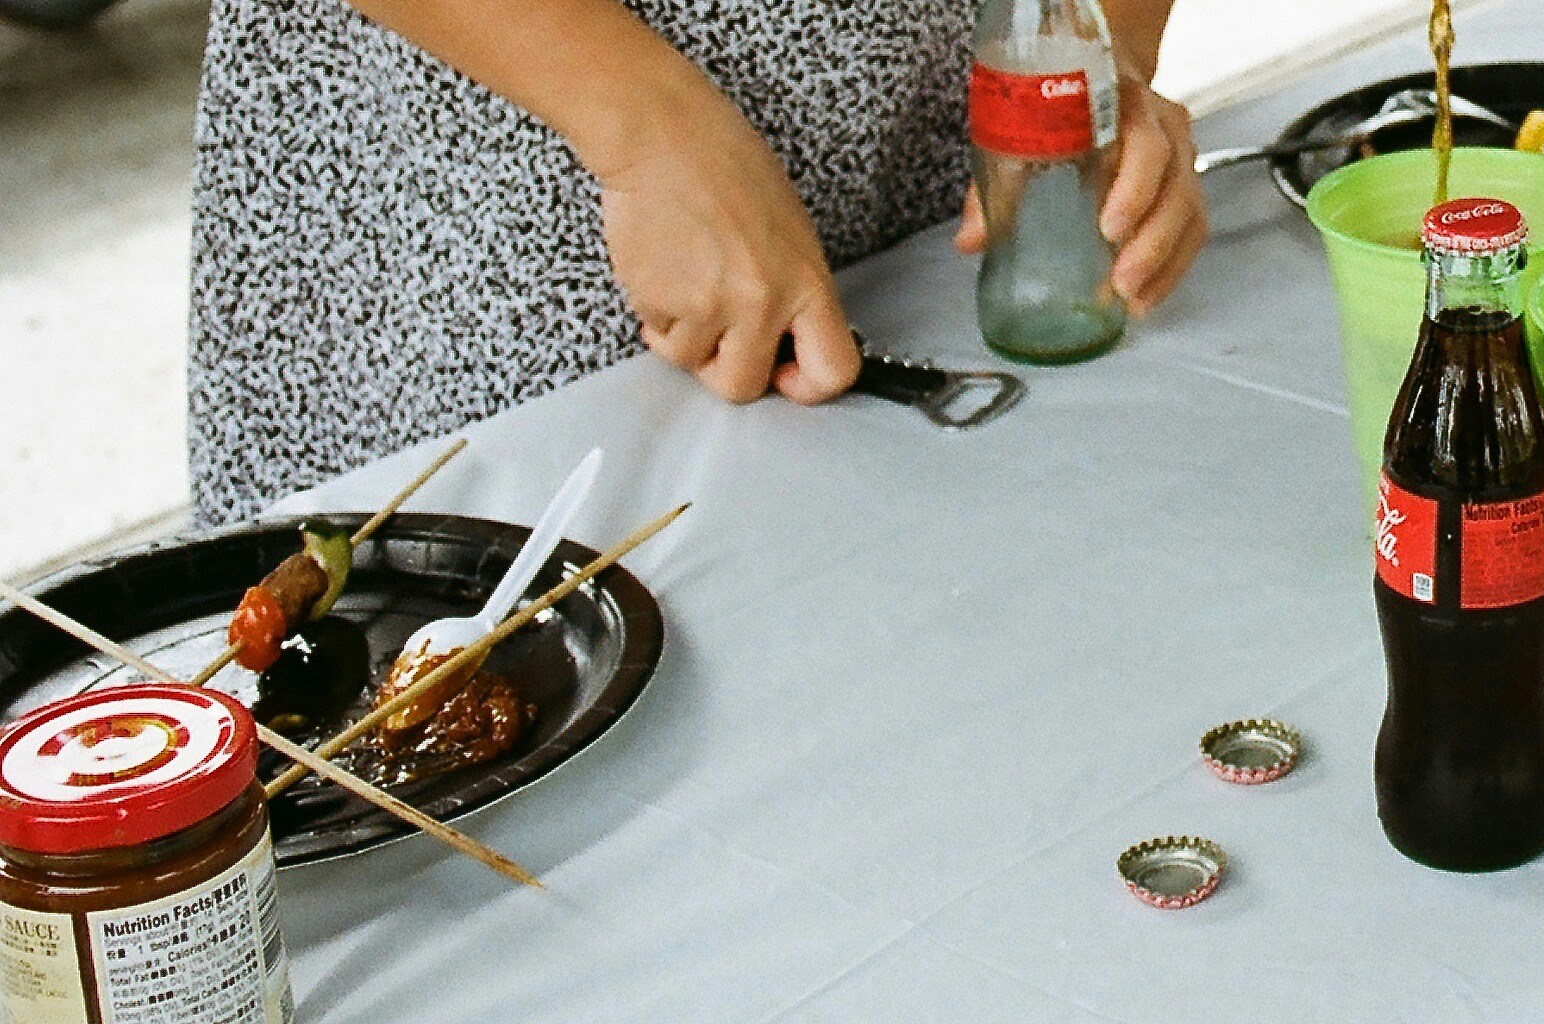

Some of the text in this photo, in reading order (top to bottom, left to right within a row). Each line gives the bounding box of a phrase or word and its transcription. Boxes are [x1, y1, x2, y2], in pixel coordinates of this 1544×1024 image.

[1465, 505, 1511, 521] Nutrition
[1513, 499, 1539, 517] Facts
[5, 915, 60, 940] SAUCE
[103, 913, 170, 938] Nutrition
